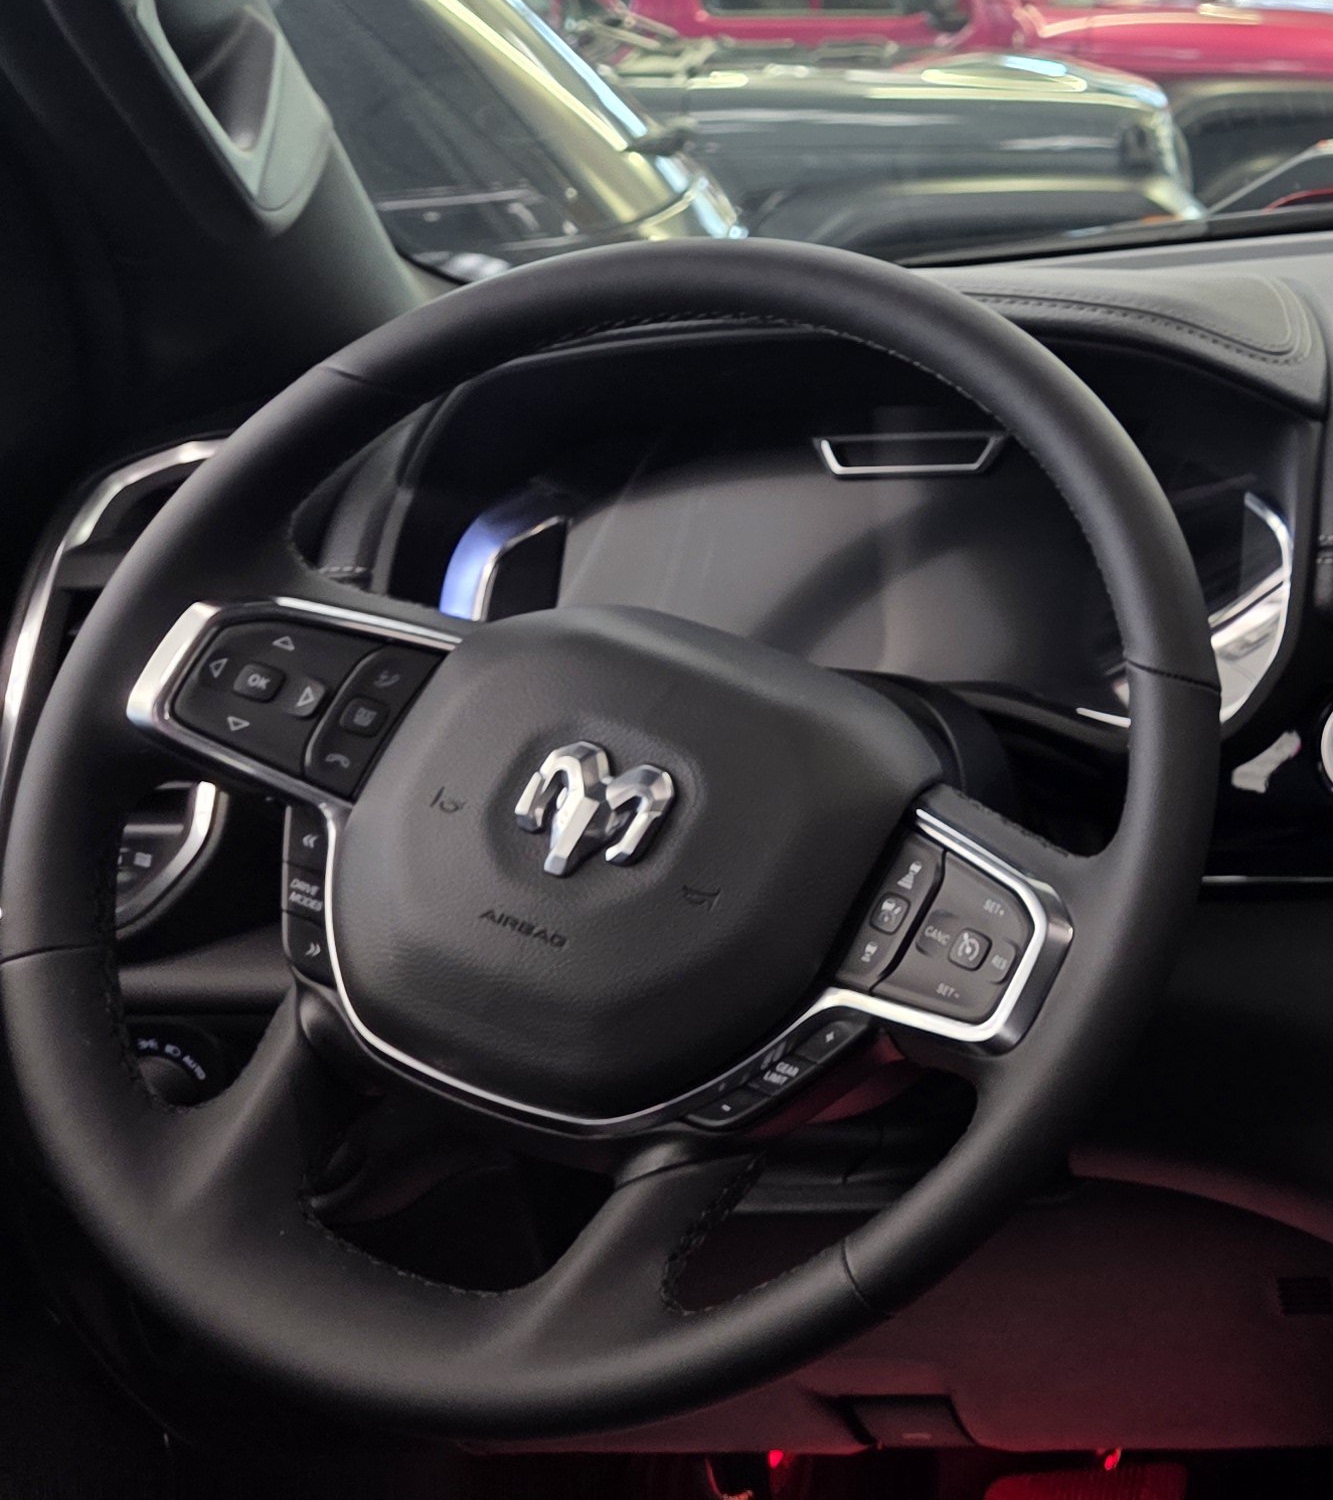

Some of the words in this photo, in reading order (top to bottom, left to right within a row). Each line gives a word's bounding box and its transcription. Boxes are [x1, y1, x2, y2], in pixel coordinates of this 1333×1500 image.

[246, 673, 271, 691] OK
[478, 908, 568, 949] AIRBAG
[923, 925, 952, 946] CANC
